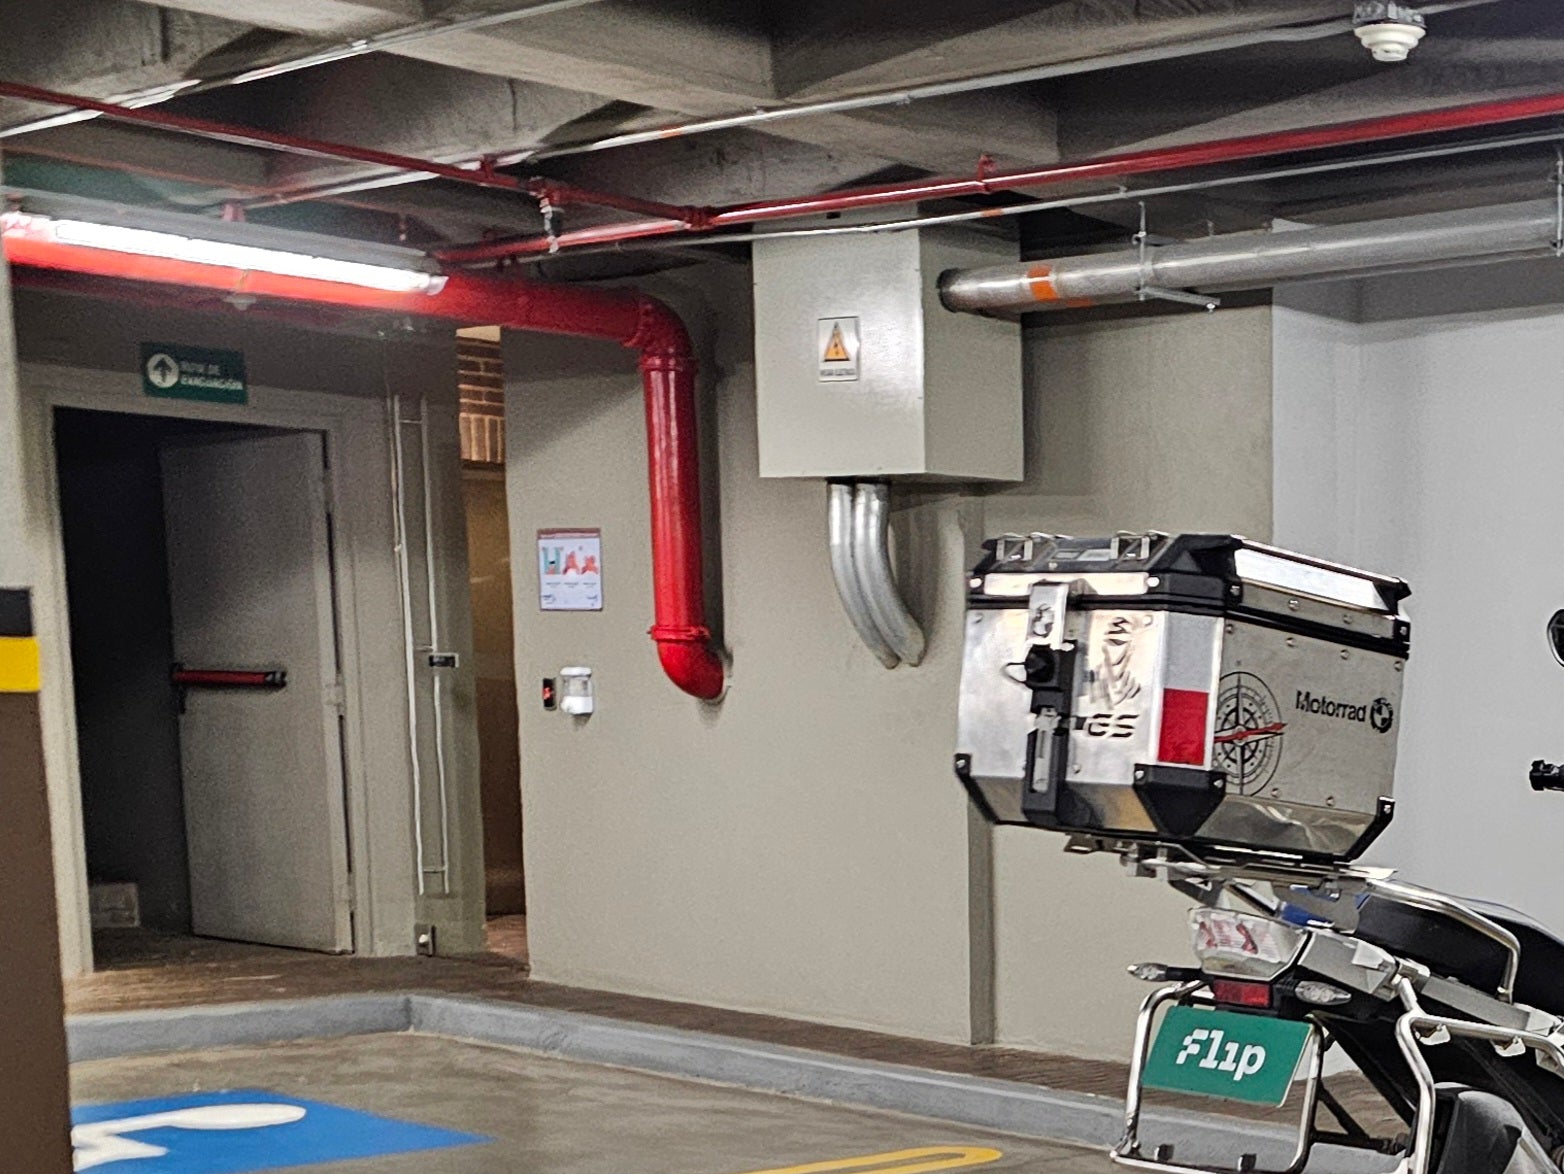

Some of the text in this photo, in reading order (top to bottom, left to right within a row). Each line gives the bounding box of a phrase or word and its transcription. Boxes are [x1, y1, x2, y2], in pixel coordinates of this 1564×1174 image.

[1296, 690, 1367, 722] Motorrad
[1088, 713, 1140, 738] GS
[1175, 1028, 1267, 1082] Flip
